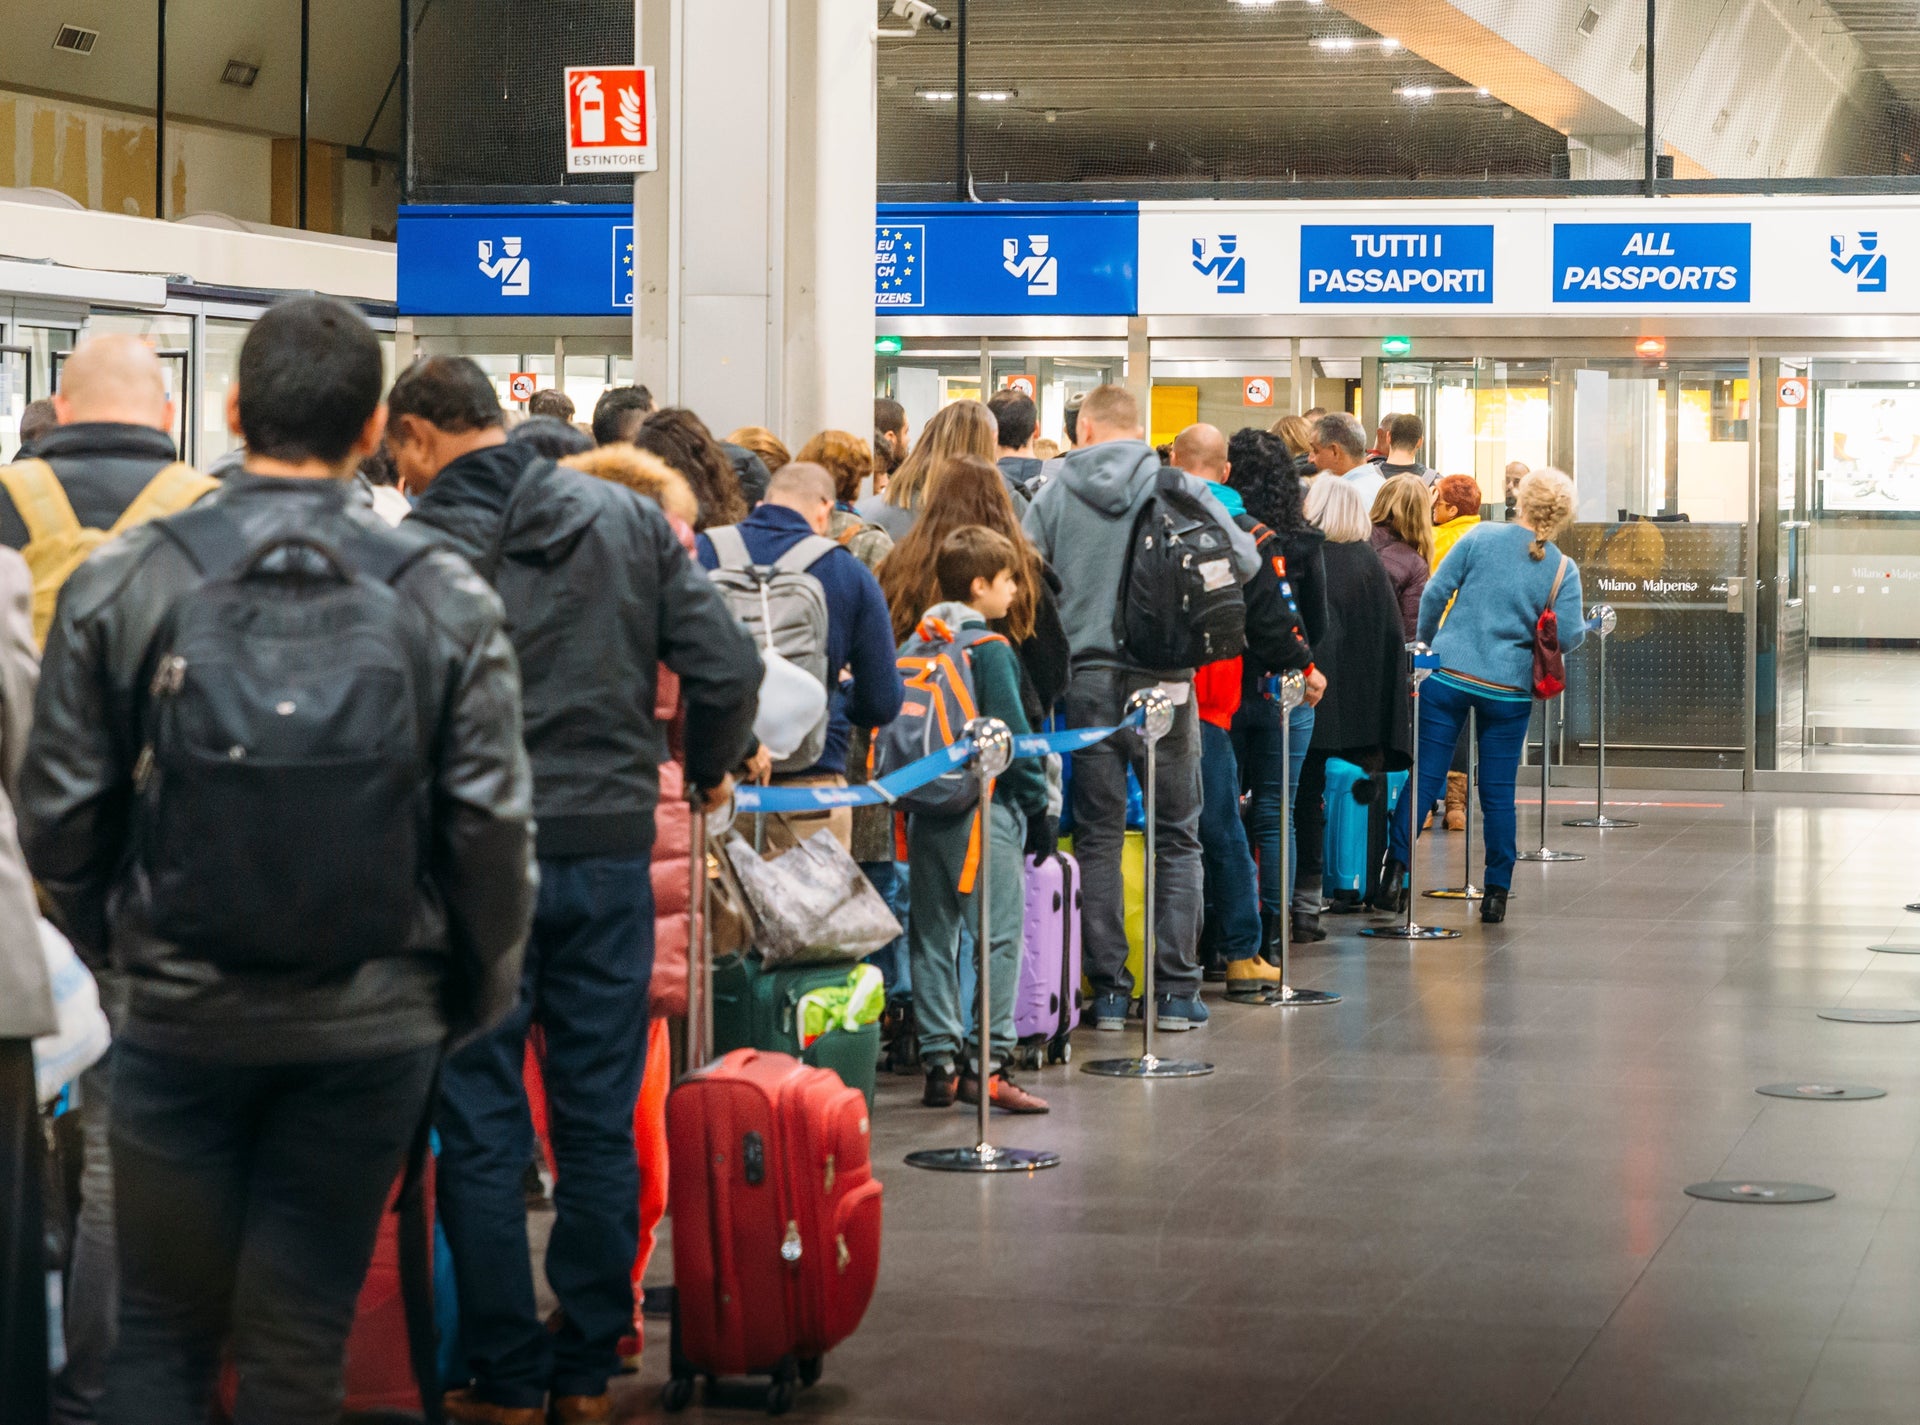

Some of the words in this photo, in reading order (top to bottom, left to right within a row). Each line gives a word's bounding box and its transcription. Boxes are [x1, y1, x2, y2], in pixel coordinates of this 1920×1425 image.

[574, 154, 645, 166] ESTINTORE
[877, 240, 894, 251] EU
[1350, 234, 1427, 258] TUTTI
[1433, 234, 1442, 258] I
[1621, 232, 1675, 256] ALL
[877, 266, 895, 277] CH
[1308, 269, 1485, 292] PASSAPORTI
[1562, 266, 1738, 290] PASSPORTS
[1598, 579, 1636, 591] Milano
[1643, 579, 1697, 593] Malpensa
